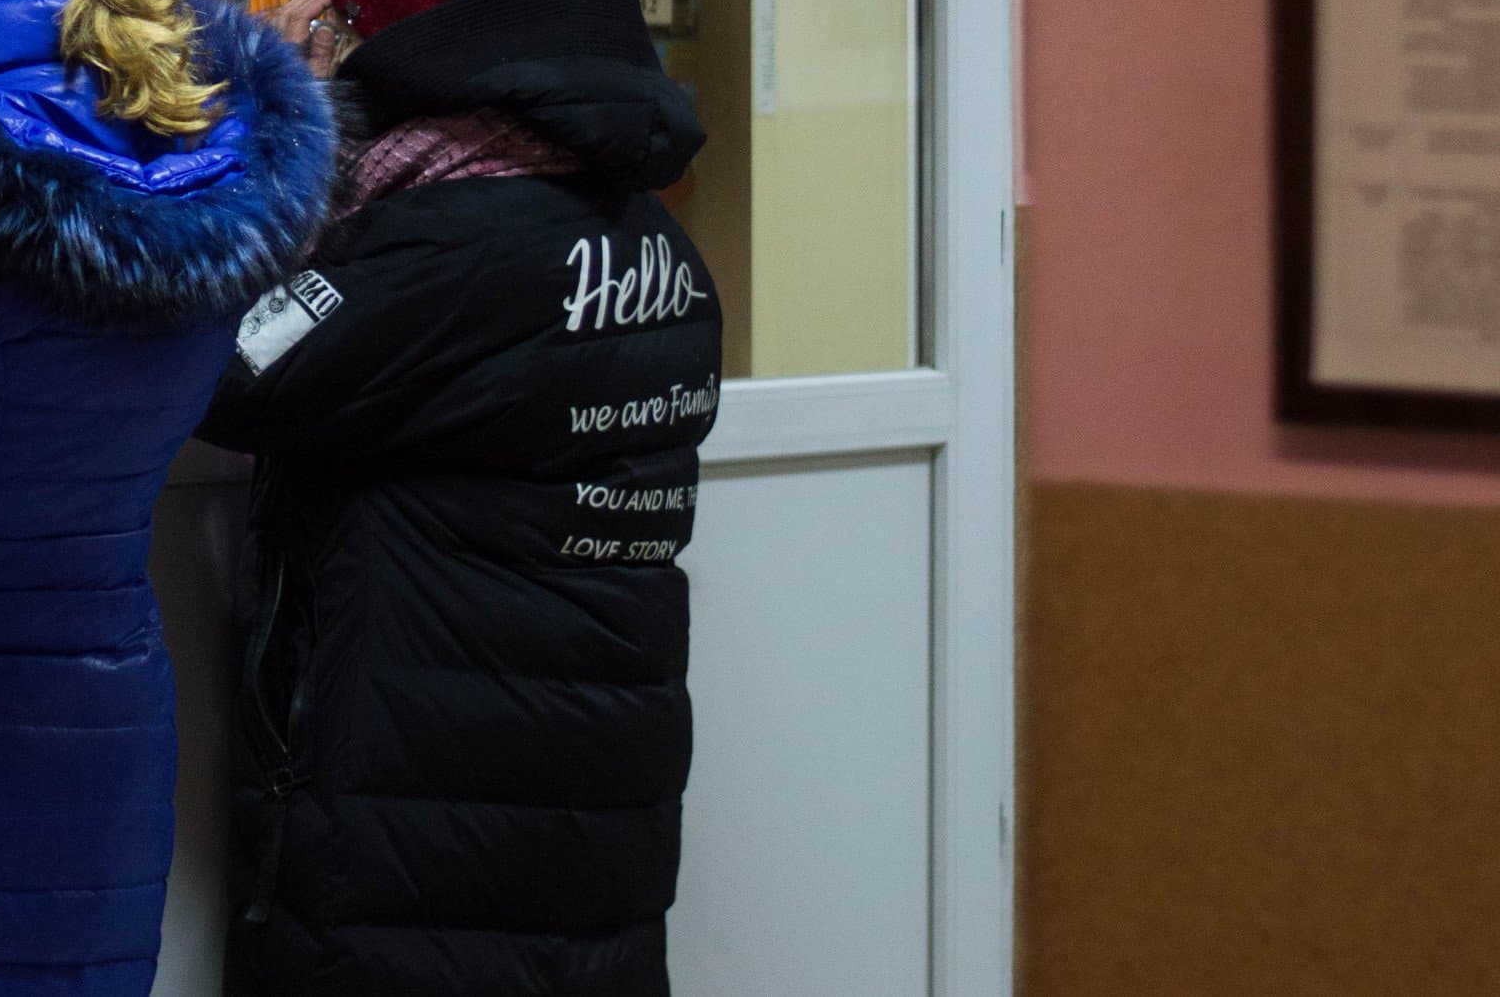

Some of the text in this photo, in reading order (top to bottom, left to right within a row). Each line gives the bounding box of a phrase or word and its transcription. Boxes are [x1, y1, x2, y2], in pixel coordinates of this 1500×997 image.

[563, 233, 707, 331] Hello
[570, 405, 619, 433] we
[621, 396, 668, 428] are
[575, 482, 626, 510] YOU
[624, 489, 663, 511] AND
[622, 540, 676, 560] STORY
